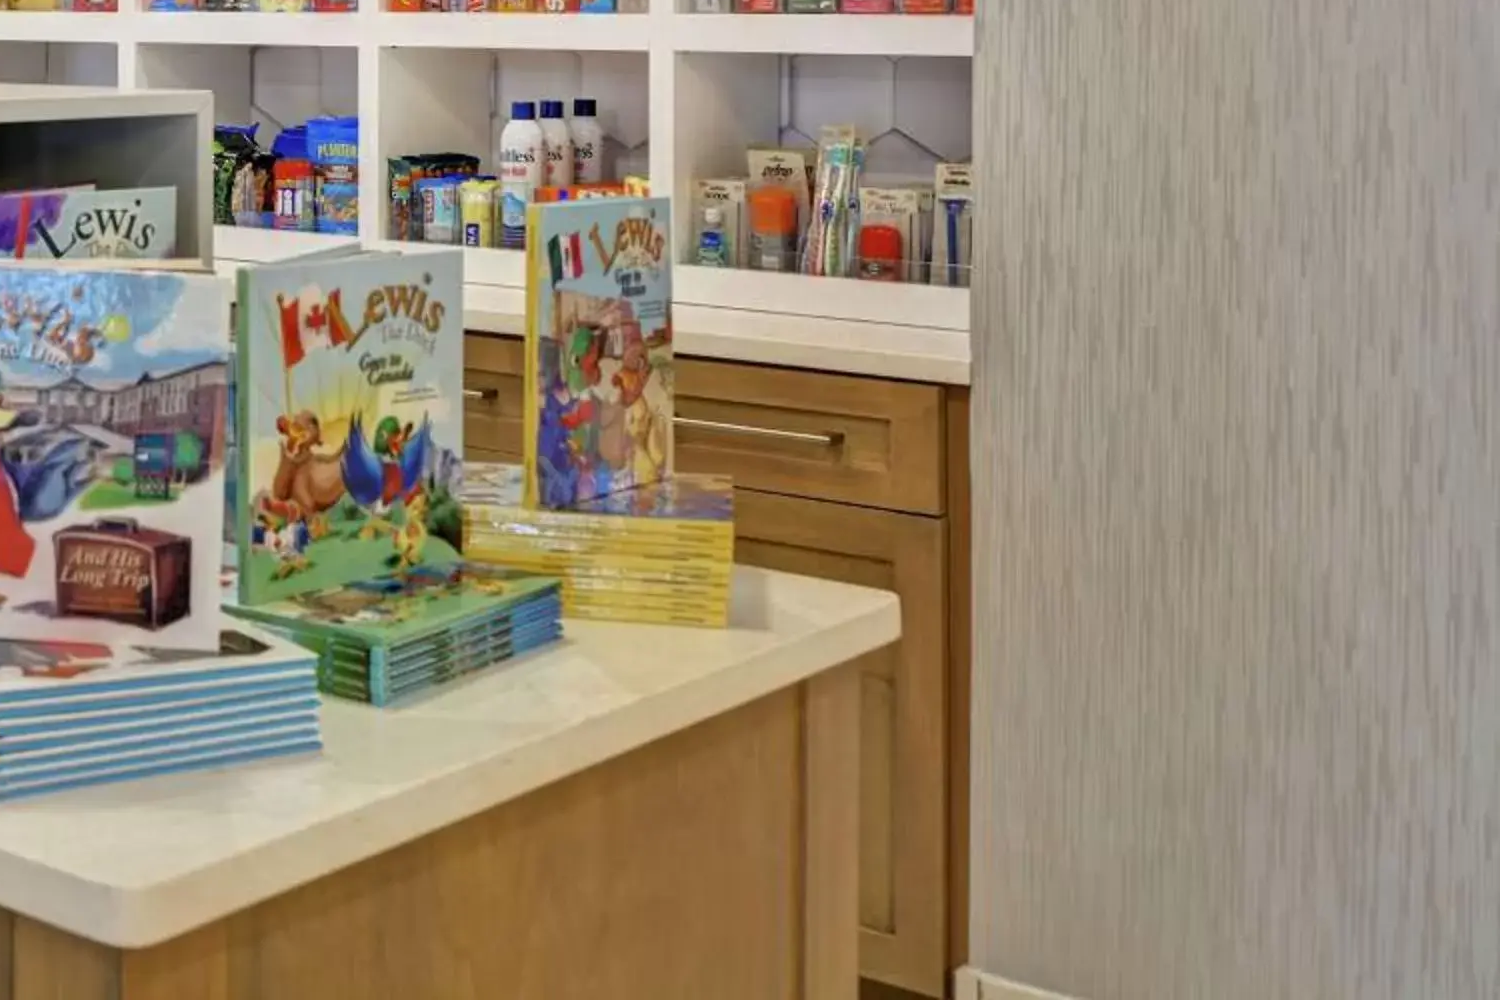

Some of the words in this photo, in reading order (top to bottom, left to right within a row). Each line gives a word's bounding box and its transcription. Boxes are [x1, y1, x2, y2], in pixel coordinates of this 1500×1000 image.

[35, 200, 155, 259] Lewis
[588, 208, 665, 277] Lewis
[69, 546, 106, 567] And
[109, 548, 142, 567] His
[60, 565, 104, 588] Long
[111, 568, 150, 595] Trip
